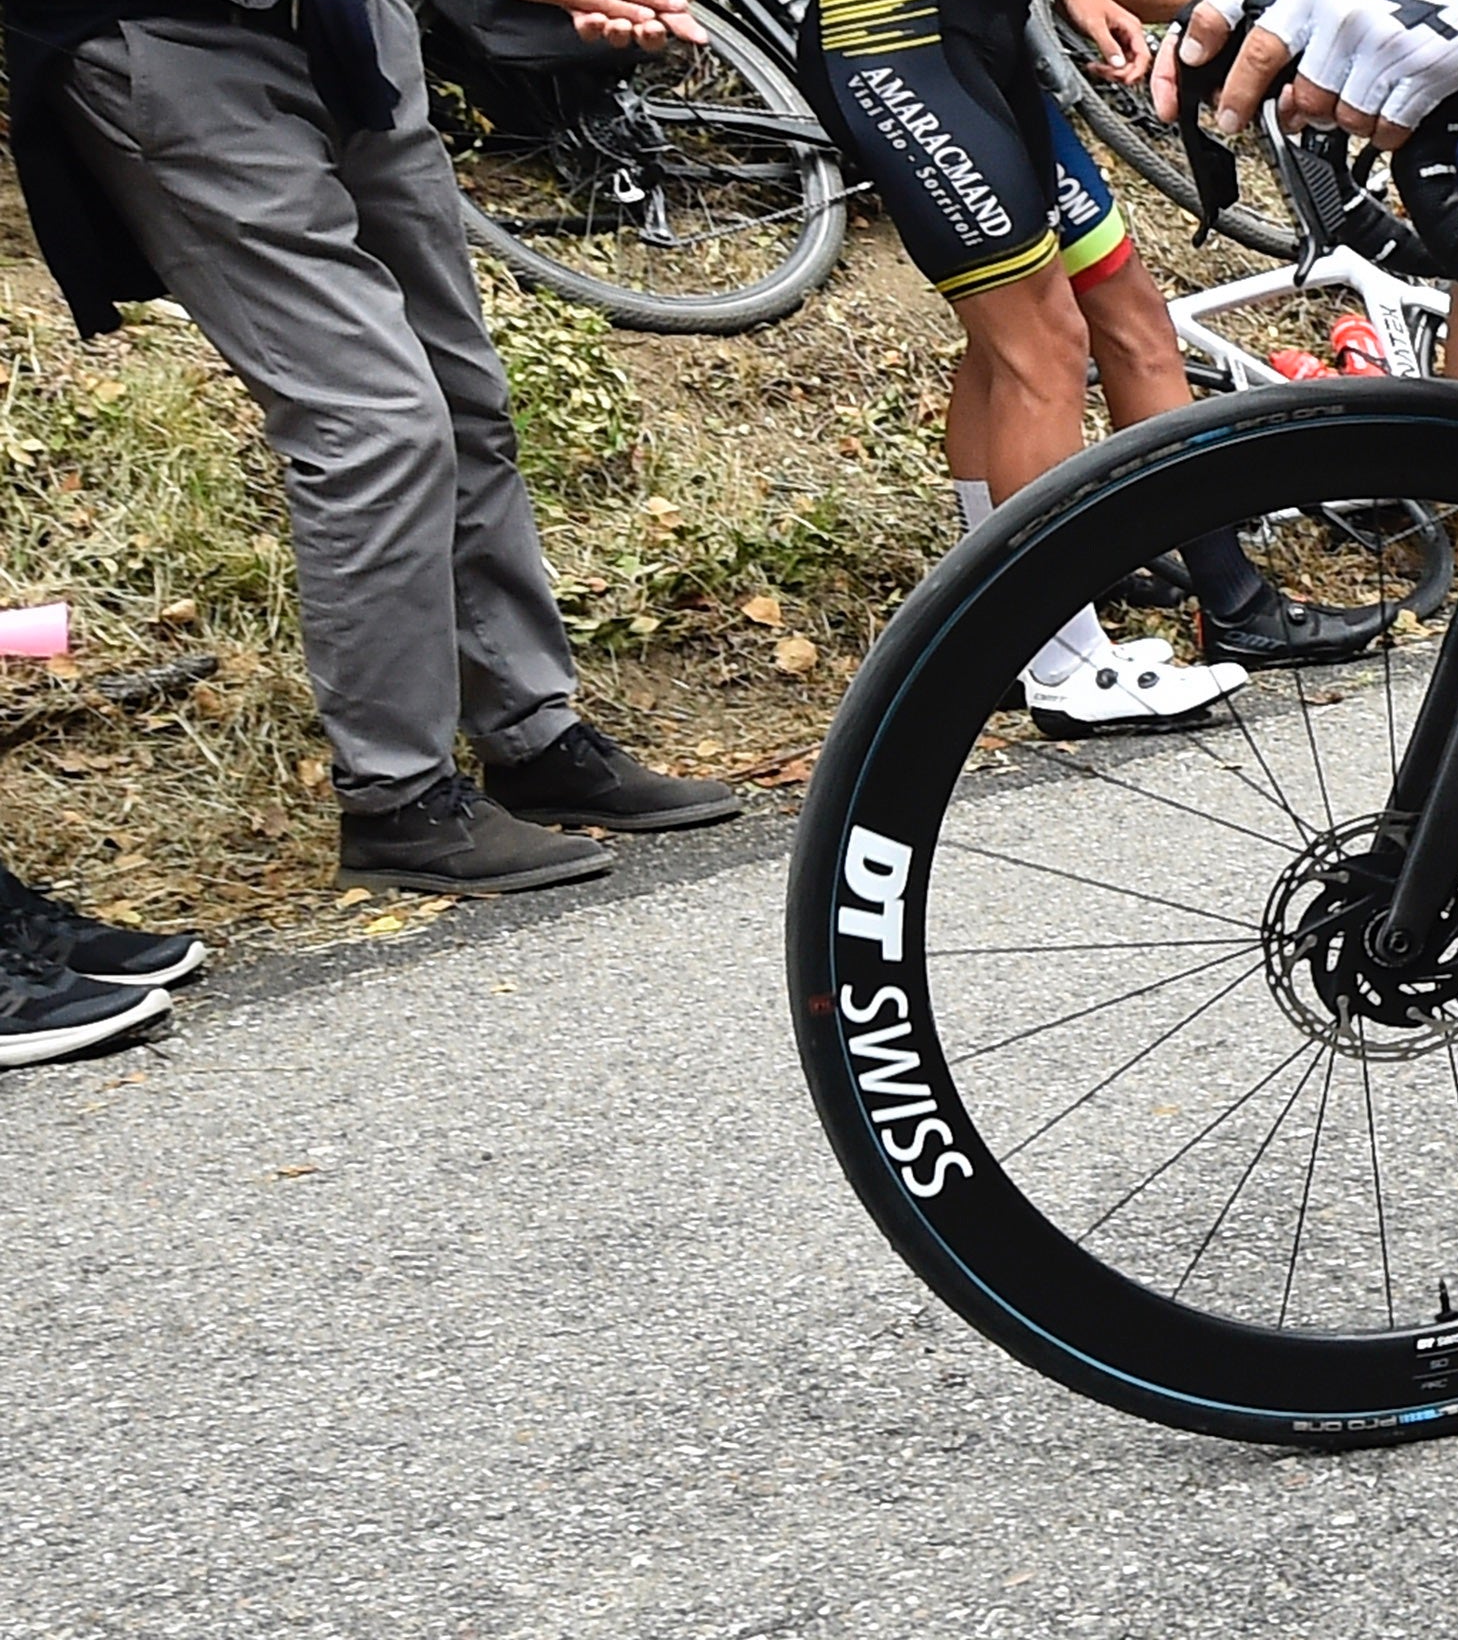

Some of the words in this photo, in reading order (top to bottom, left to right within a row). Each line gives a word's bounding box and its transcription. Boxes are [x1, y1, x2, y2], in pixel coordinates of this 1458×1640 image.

[861, 67, 1012, 237] AMARACMAND
[915, 166, 983, 247] Sorrivoli
[1379, 304, 1416, 377] NATEK
[838, 825, 913, 961] DT
[840, 984, 974, 1198] SWISS
